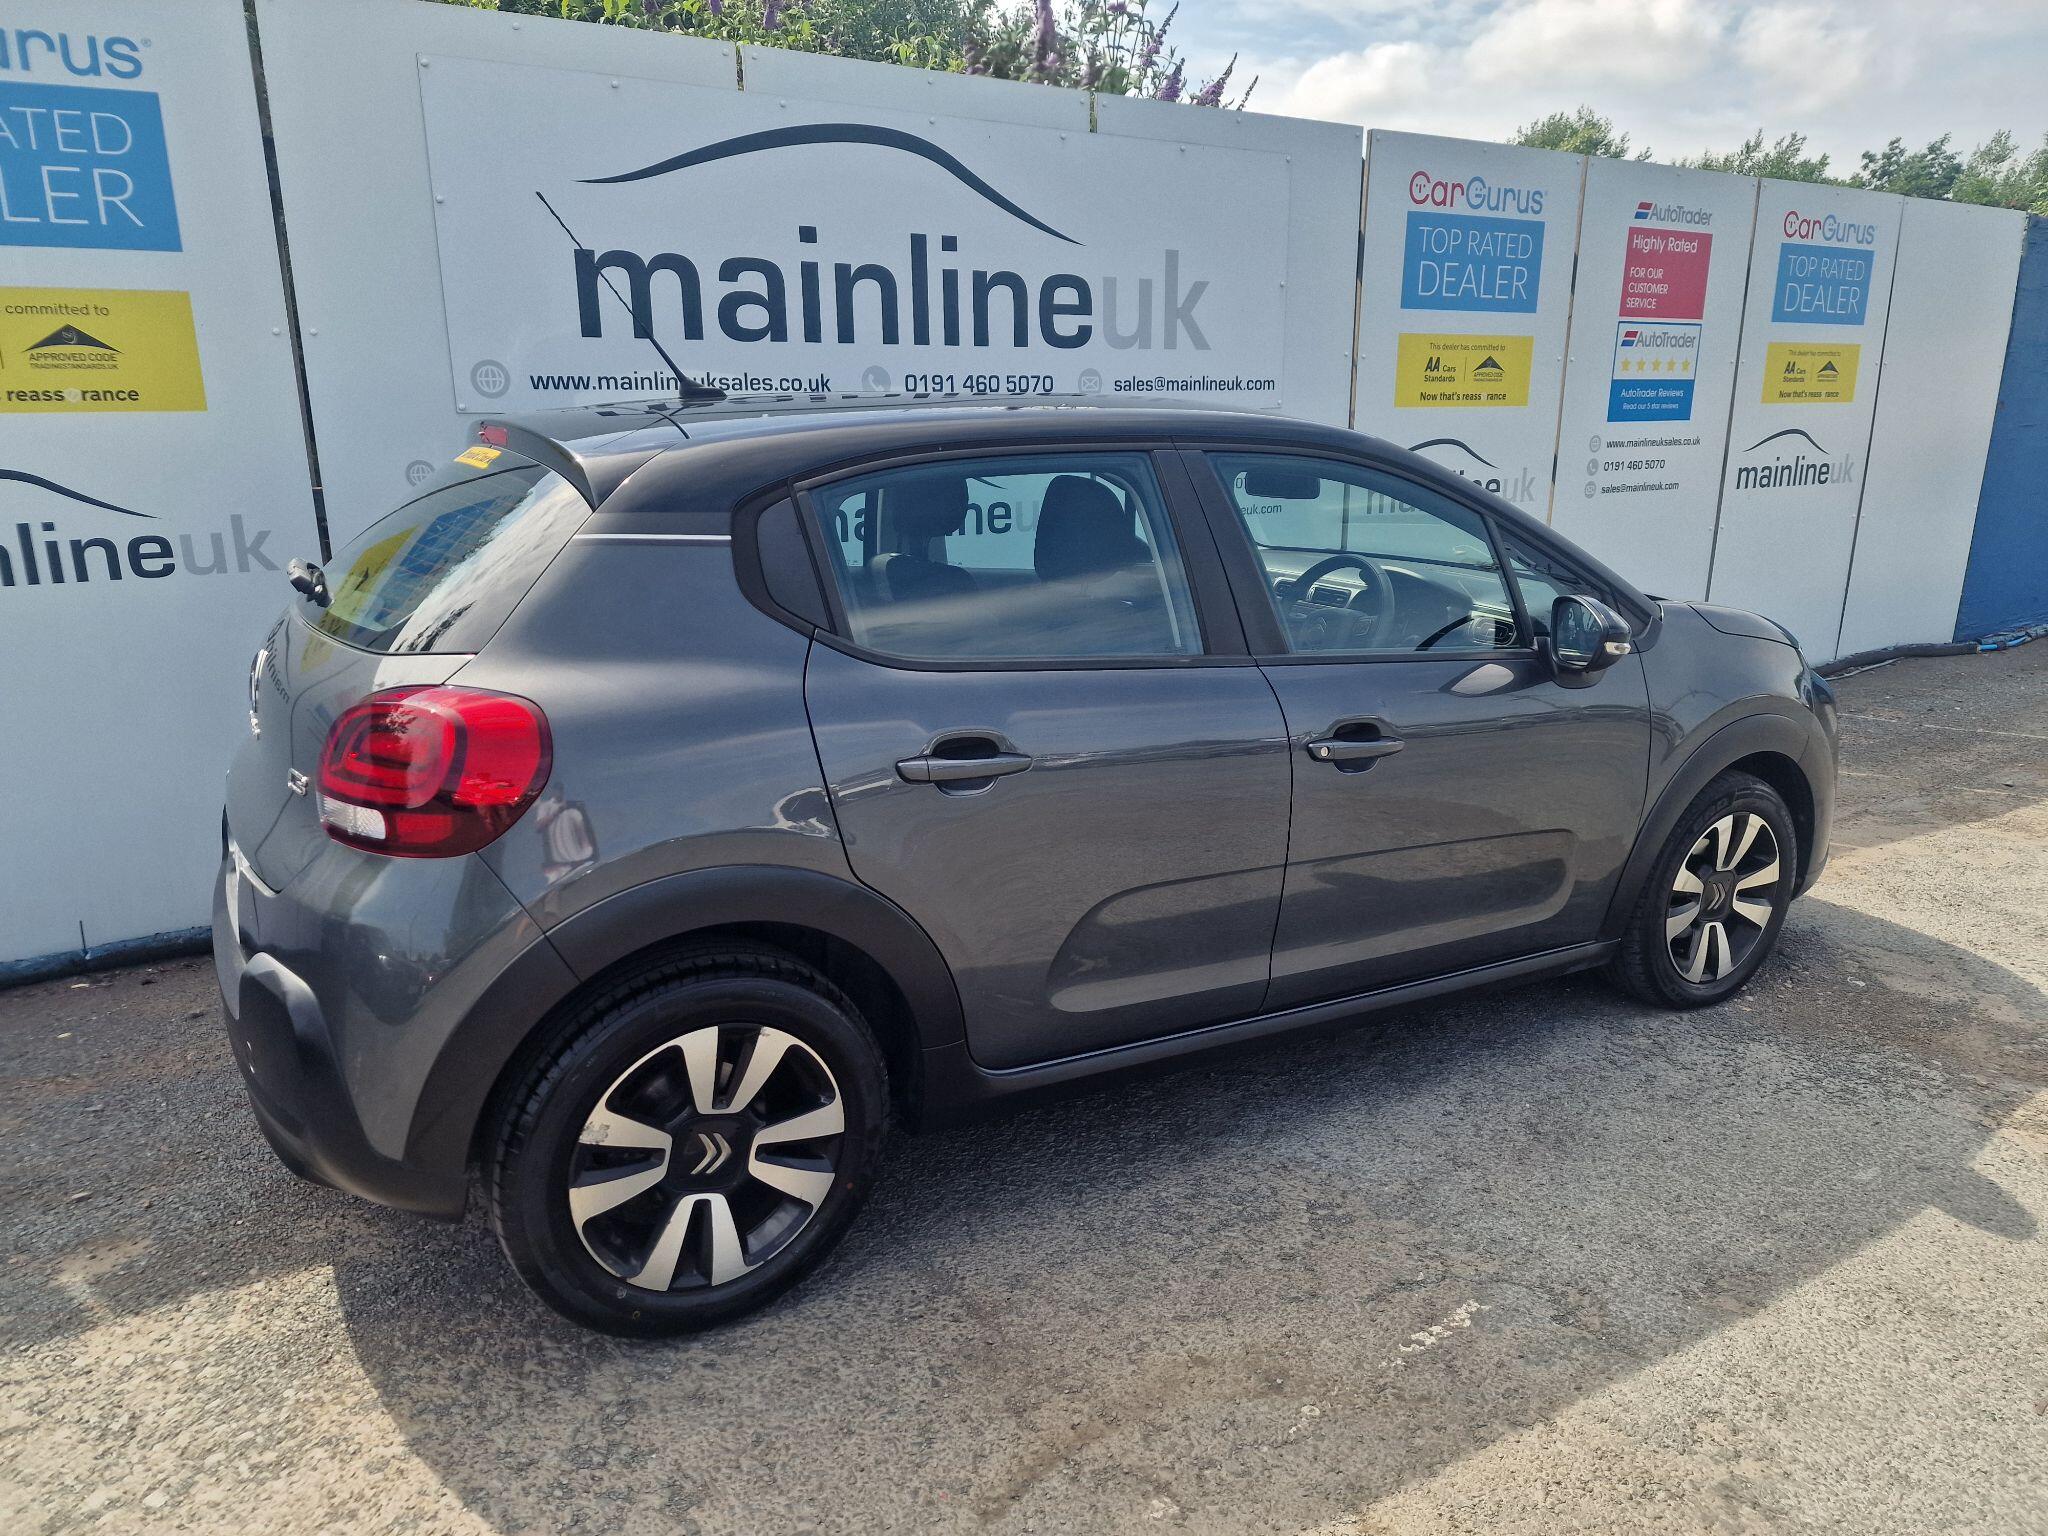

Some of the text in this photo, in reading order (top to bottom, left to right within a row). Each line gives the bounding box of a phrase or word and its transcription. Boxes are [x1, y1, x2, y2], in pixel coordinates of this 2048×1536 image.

[1408, 170, 1544, 215] CarGurus
[1650, 203, 1713, 225] AutoTrader
[1783, 210, 1876, 245] CarGurus
[1418, 226, 1533, 259] TOP RATED
[1633, 234, 1699, 254] Highly Rated
[1629, 266, 1664, 279] FOR OUR
[1788, 254, 1865, 281] TOP RATED
[573, 224, 1212, 350] mainlineuk
[1417, 260, 1528, 300] DEALER
[1628, 282, 1669, 295] CUSTOMER
[1626, 297, 1657, 309] SERVICE
[1783, 282, 1861, 314] DEALER
[5, 303, 110, 316] committed to
[1634, 330, 1697, 349] AutoTrader
[29, 352, 118, 361] APPROVED CODE
[1424, 356, 1457, 373] AA Cars
[529, 370, 832, 393] www.mainlinksales.co.uk
[904, 374, 1054, 393] 0191 460 5070
[1113, 375, 1276, 393] sales@mainlineuk.com
[1423, 374, 1456, 383] Standards
[6, 388, 140, 402] reassrance
[1419, 391, 1507, 402] Now that's reassrance
[1620, 388, 1684, 398] AutoTrader Reviews
[1622, 402, 1637, 410] Read
[1603, 459, 1666, 472] 0191 460 5070
[1736, 453, 1855, 490] mainlineuk
